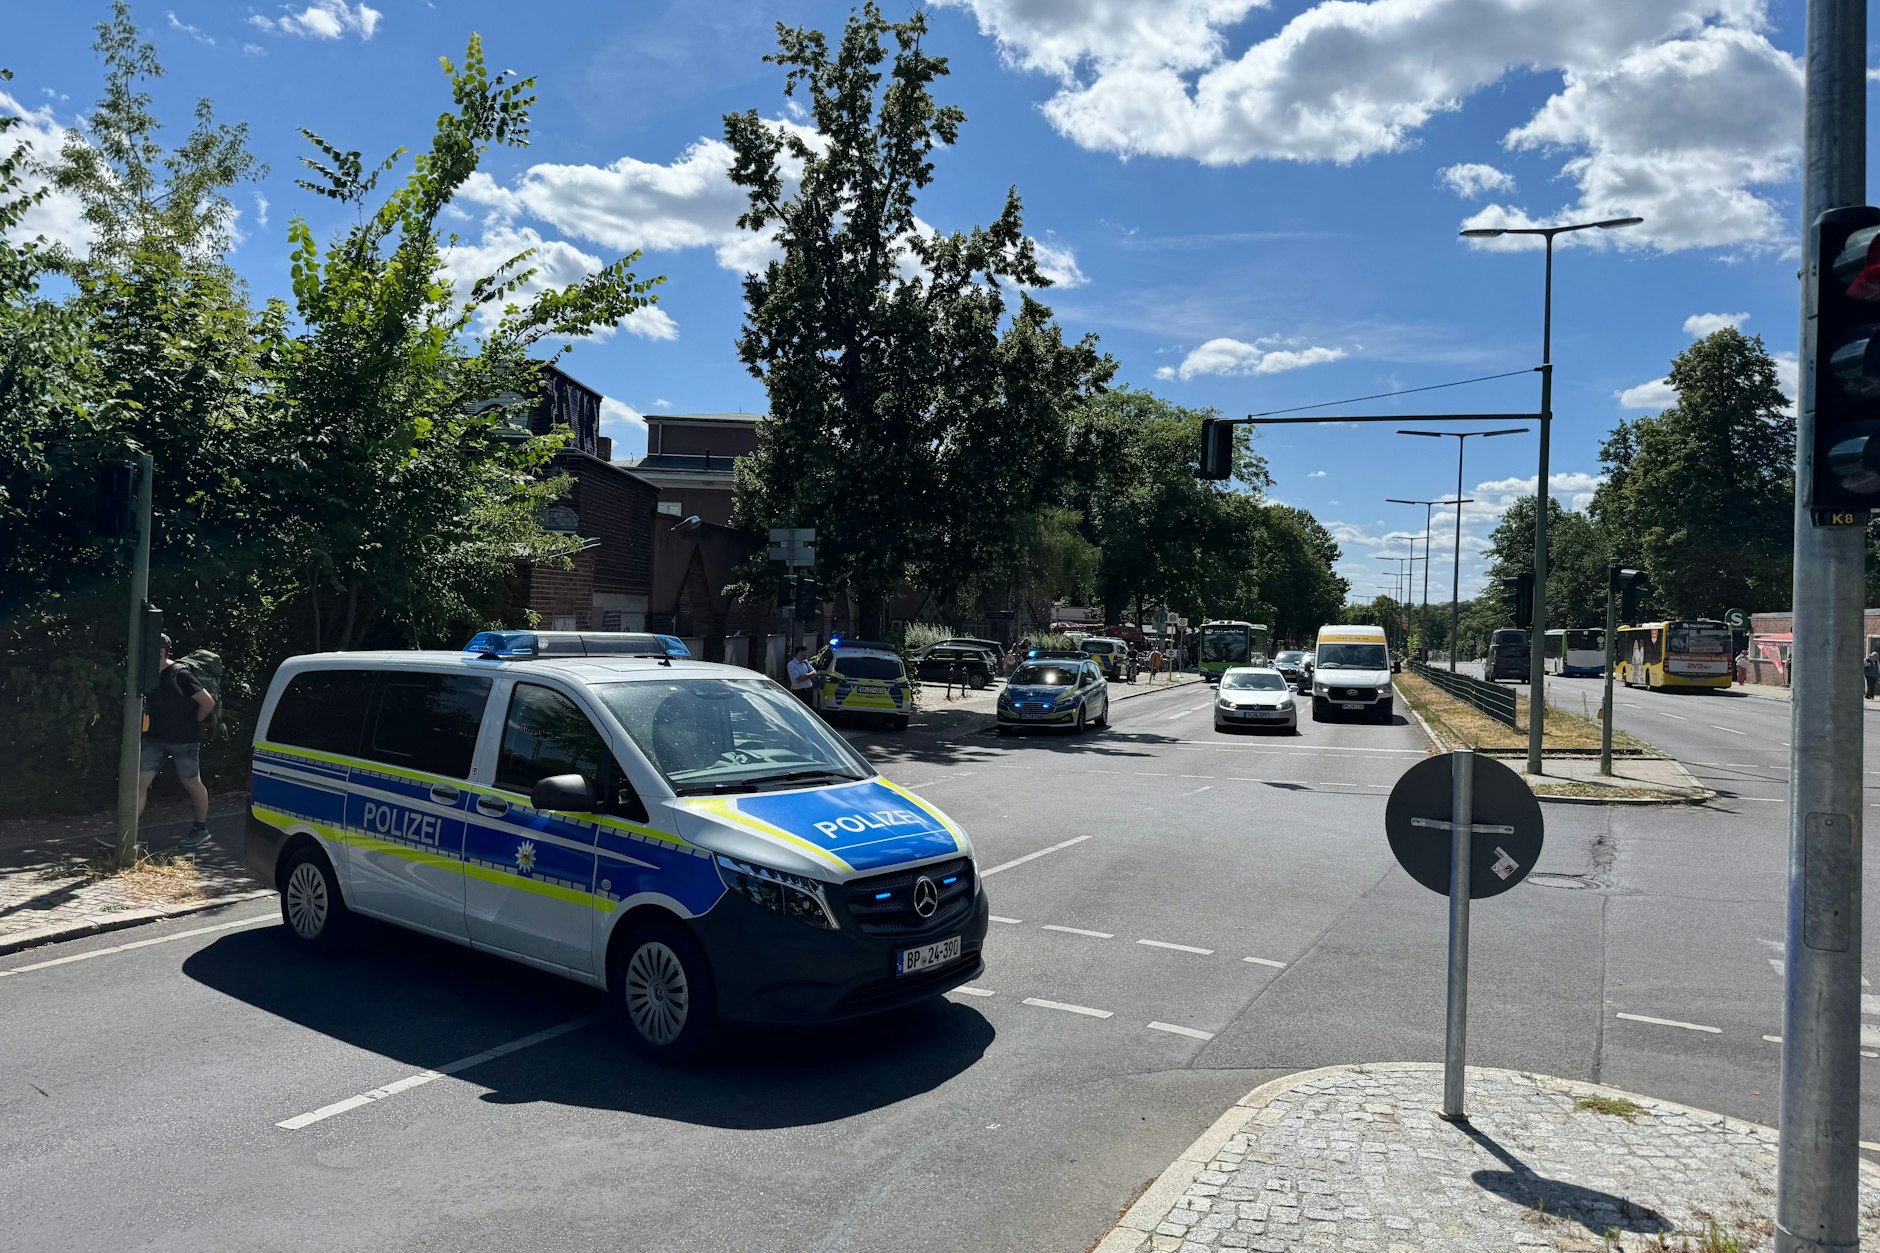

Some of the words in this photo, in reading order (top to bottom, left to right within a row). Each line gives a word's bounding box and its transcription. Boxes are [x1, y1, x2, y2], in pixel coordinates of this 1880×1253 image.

[1833, 513, 1853, 524] K8
[1730, 612, 1744, 626] S
[363, 802, 442, 846] POLIZEI
[813, 809, 928, 839] POLIZEI
[907, 950, 921, 970] BP
[928, 939, 959, 964] 24-390
